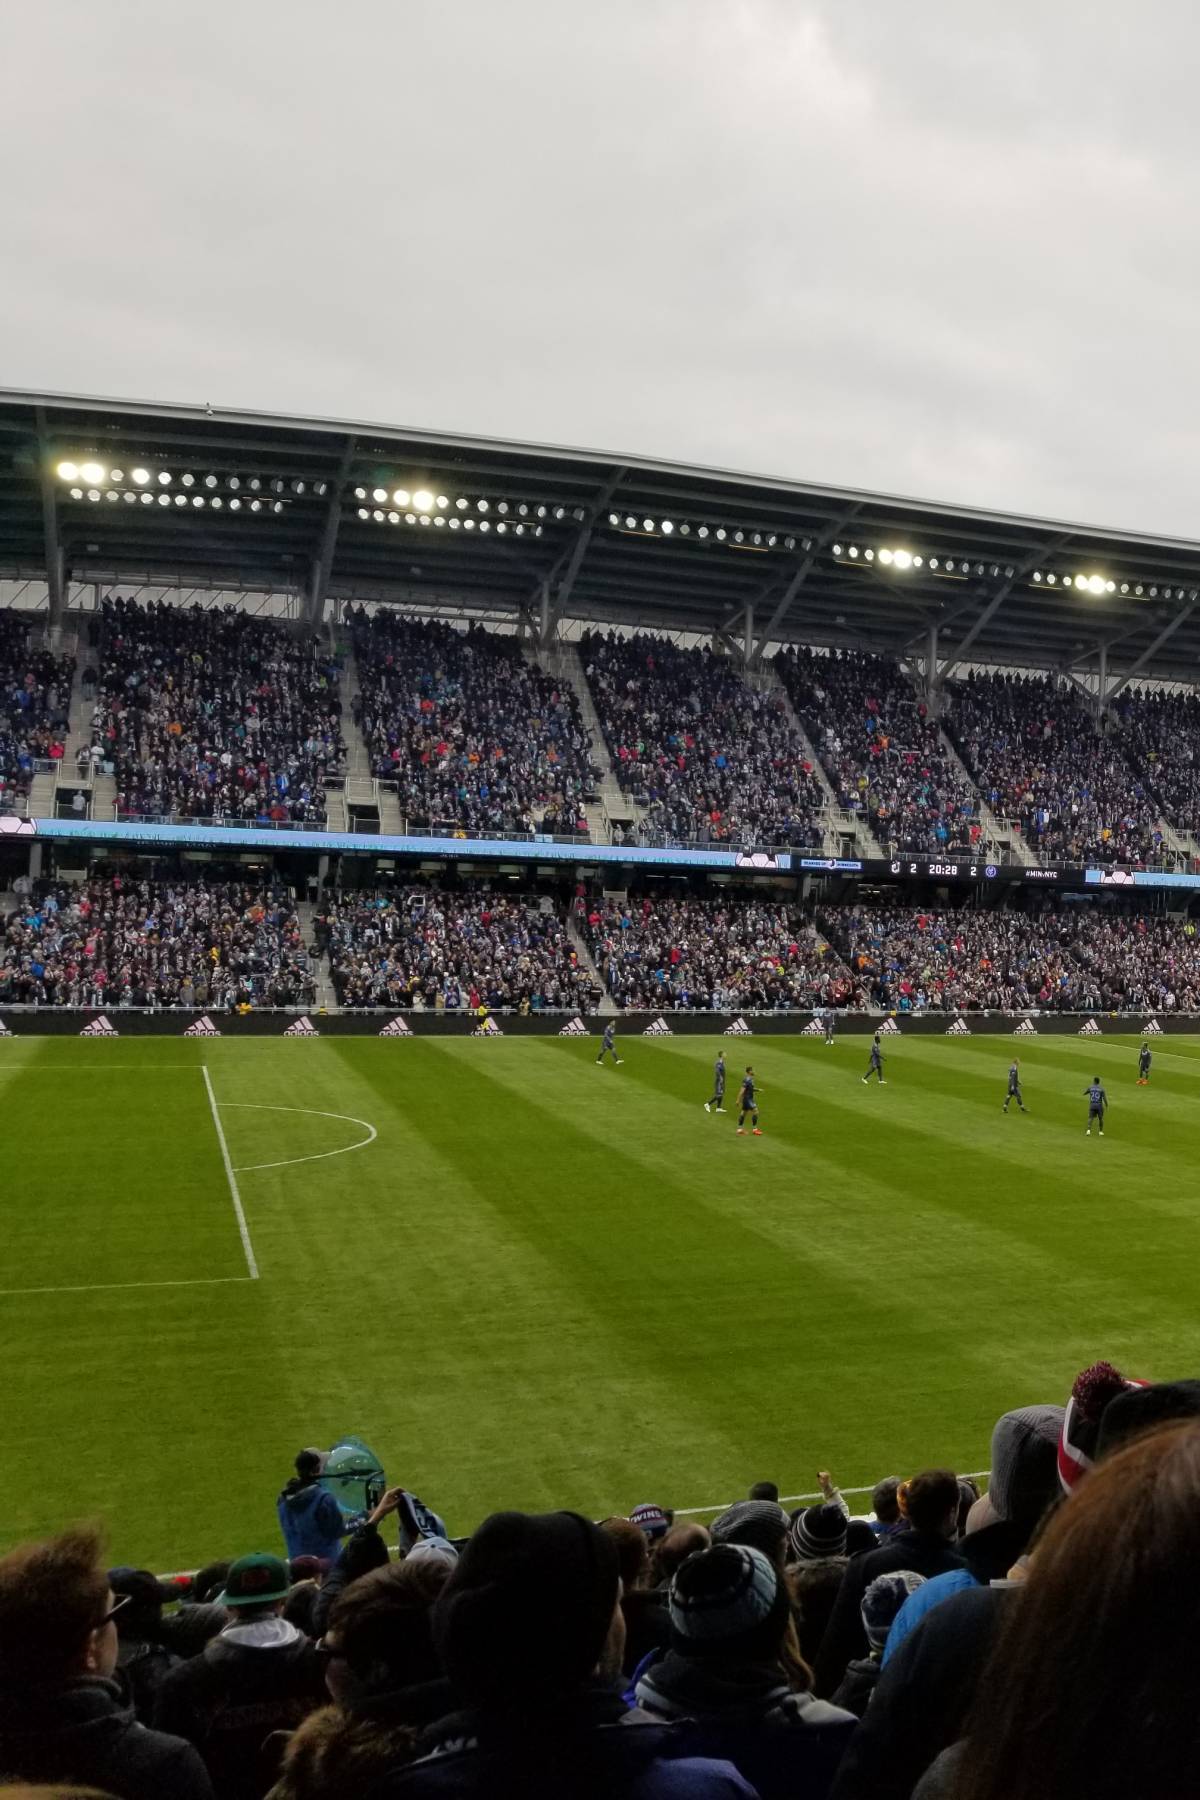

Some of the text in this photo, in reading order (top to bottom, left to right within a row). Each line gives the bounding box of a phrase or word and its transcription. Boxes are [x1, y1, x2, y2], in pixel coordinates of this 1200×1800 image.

[910, 863, 977, 876] 2 20:28 2
[79, 1029, 119, 1037] adidas
[184, 1029, 222, 1037] adidas
[283, 1029, 320, 1037] adidas
